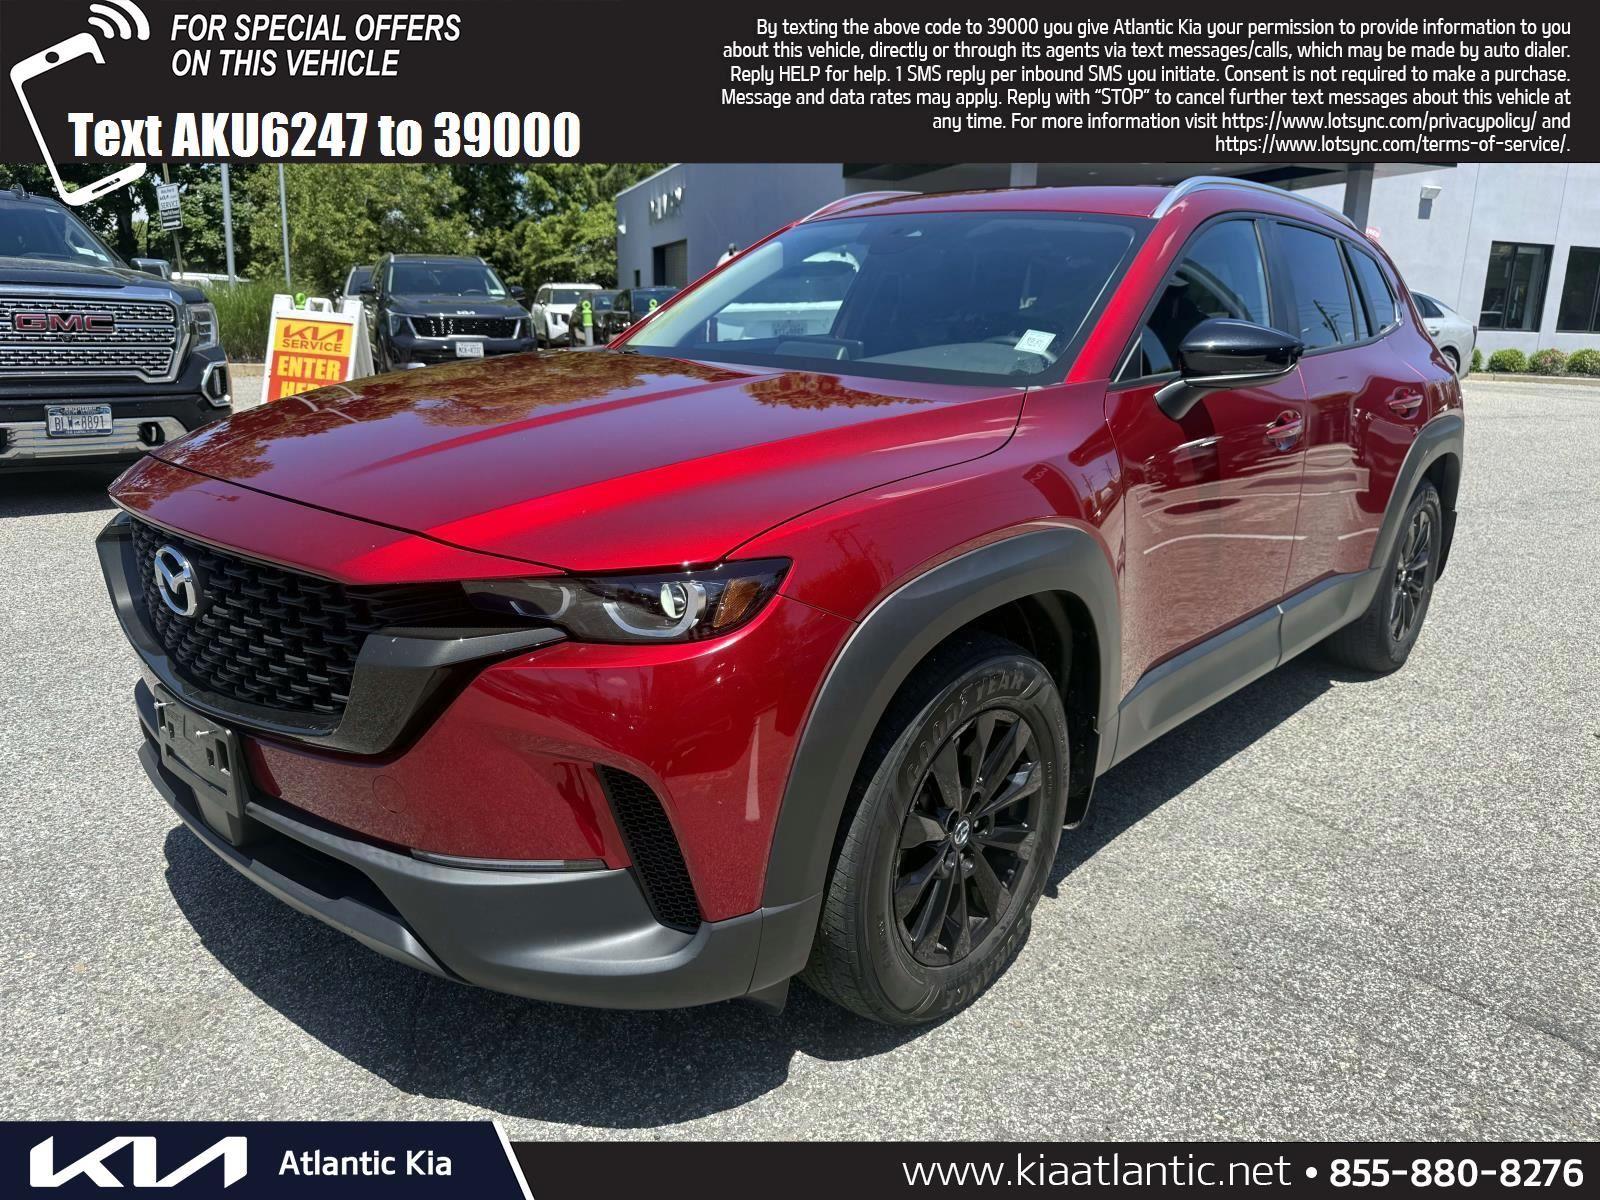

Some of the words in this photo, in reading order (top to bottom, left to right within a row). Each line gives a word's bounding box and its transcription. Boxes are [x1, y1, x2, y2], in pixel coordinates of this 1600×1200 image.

[15, 314, 114, 332] GMC
[283, 324, 345, 342] KIA
[281, 339, 344, 353] SERVICE
[277, 355, 342, 381] ENTER
